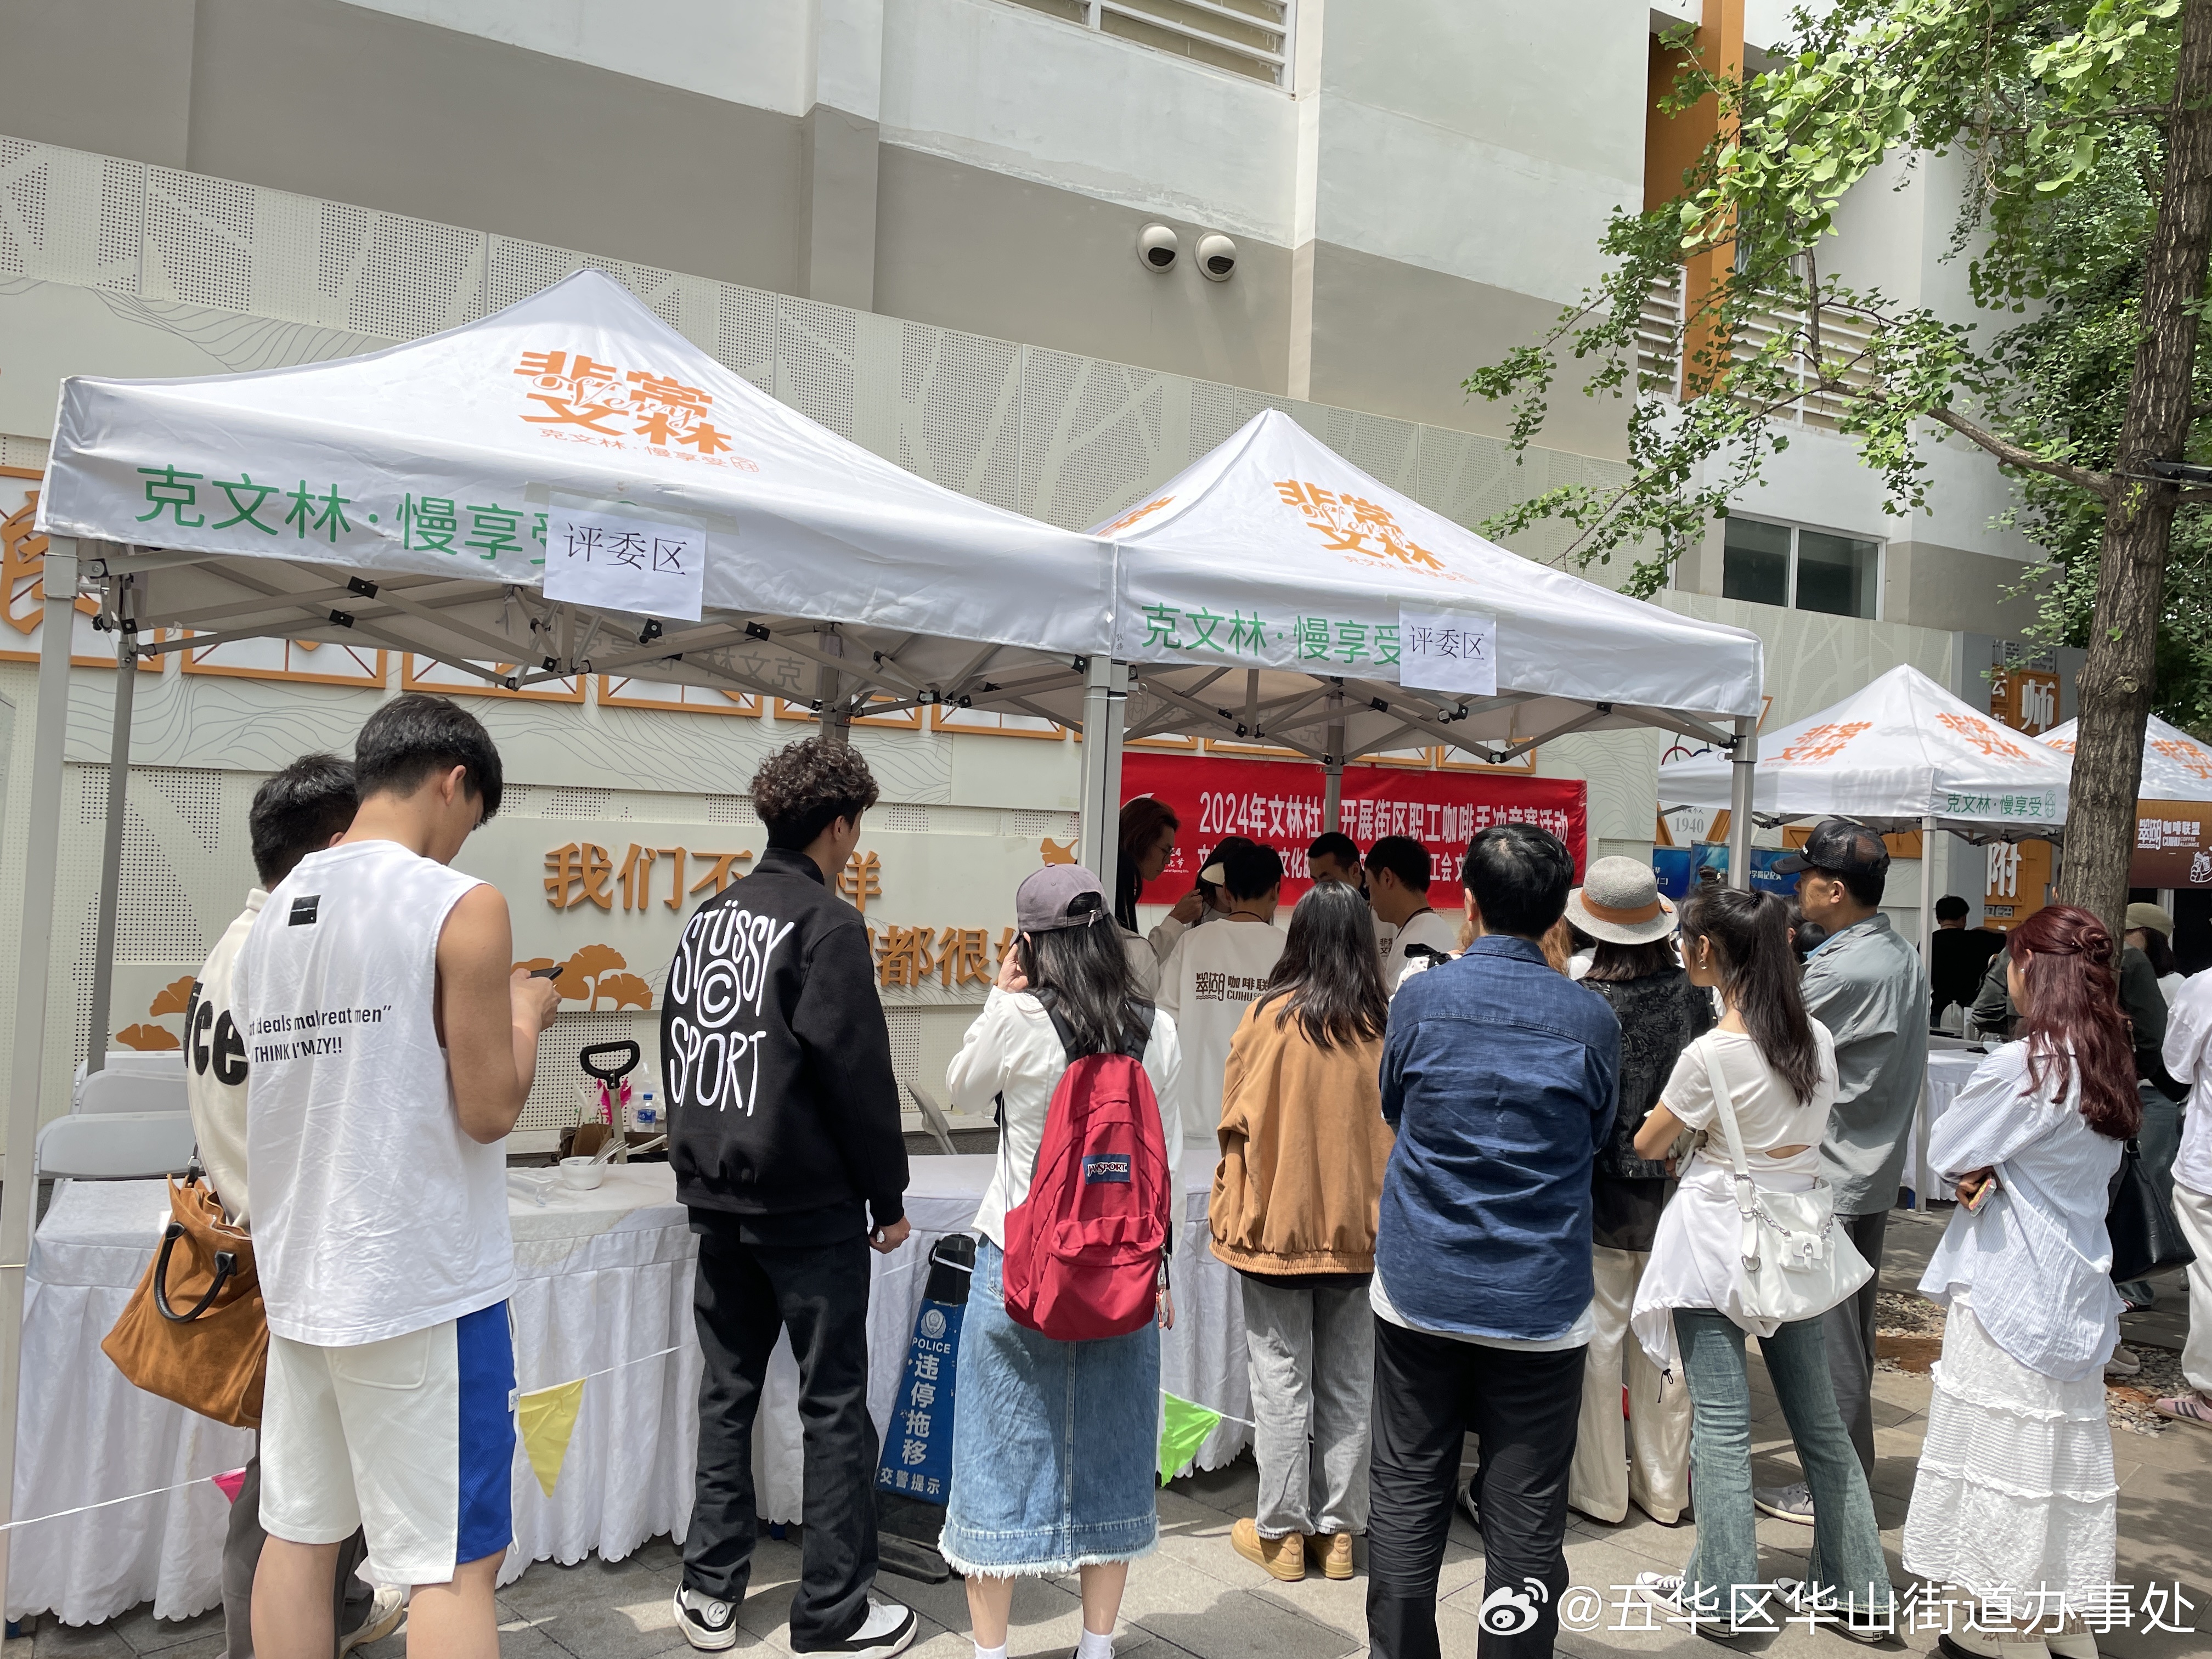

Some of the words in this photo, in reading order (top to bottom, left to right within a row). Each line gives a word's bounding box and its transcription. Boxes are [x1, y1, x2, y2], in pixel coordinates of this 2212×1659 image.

[518, 393, 734, 454] 文林
[136, 464, 547, 566] 克文林·慢享
[563, 522, 687, 575] 评委区
[1142, 602, 1400, 666] 克文林·慢享受
[1409, 625, 1486, 661] 评委区
[1199, 792, 1569, 846] 2024年文林社开展街区职工咖啡手冲活动
[1674, 817, 1704, 833] 1940
[1946, 792, 2042, 816] 克文林·慢享受
[2163, 820, 2200, 836] 咖啡联盟
[544, 842, 883, 913] 我们不样
[1986, 842, 2022, 898] 附
[672, 900, 794, 1017] STÜSSY
[868, 925, 1017, 987] 都很
[1227, 990, 1252, 1001] CUIHU
[255, 1043, 290, 1063] THINK
[669, 1017, 767, 1118] SPORT
[912, 1337, 951, 1354] POLICE
[901, 1353, 940, 1466] 违停拖移
[879, 1466, 940, 1496] 交警提示
